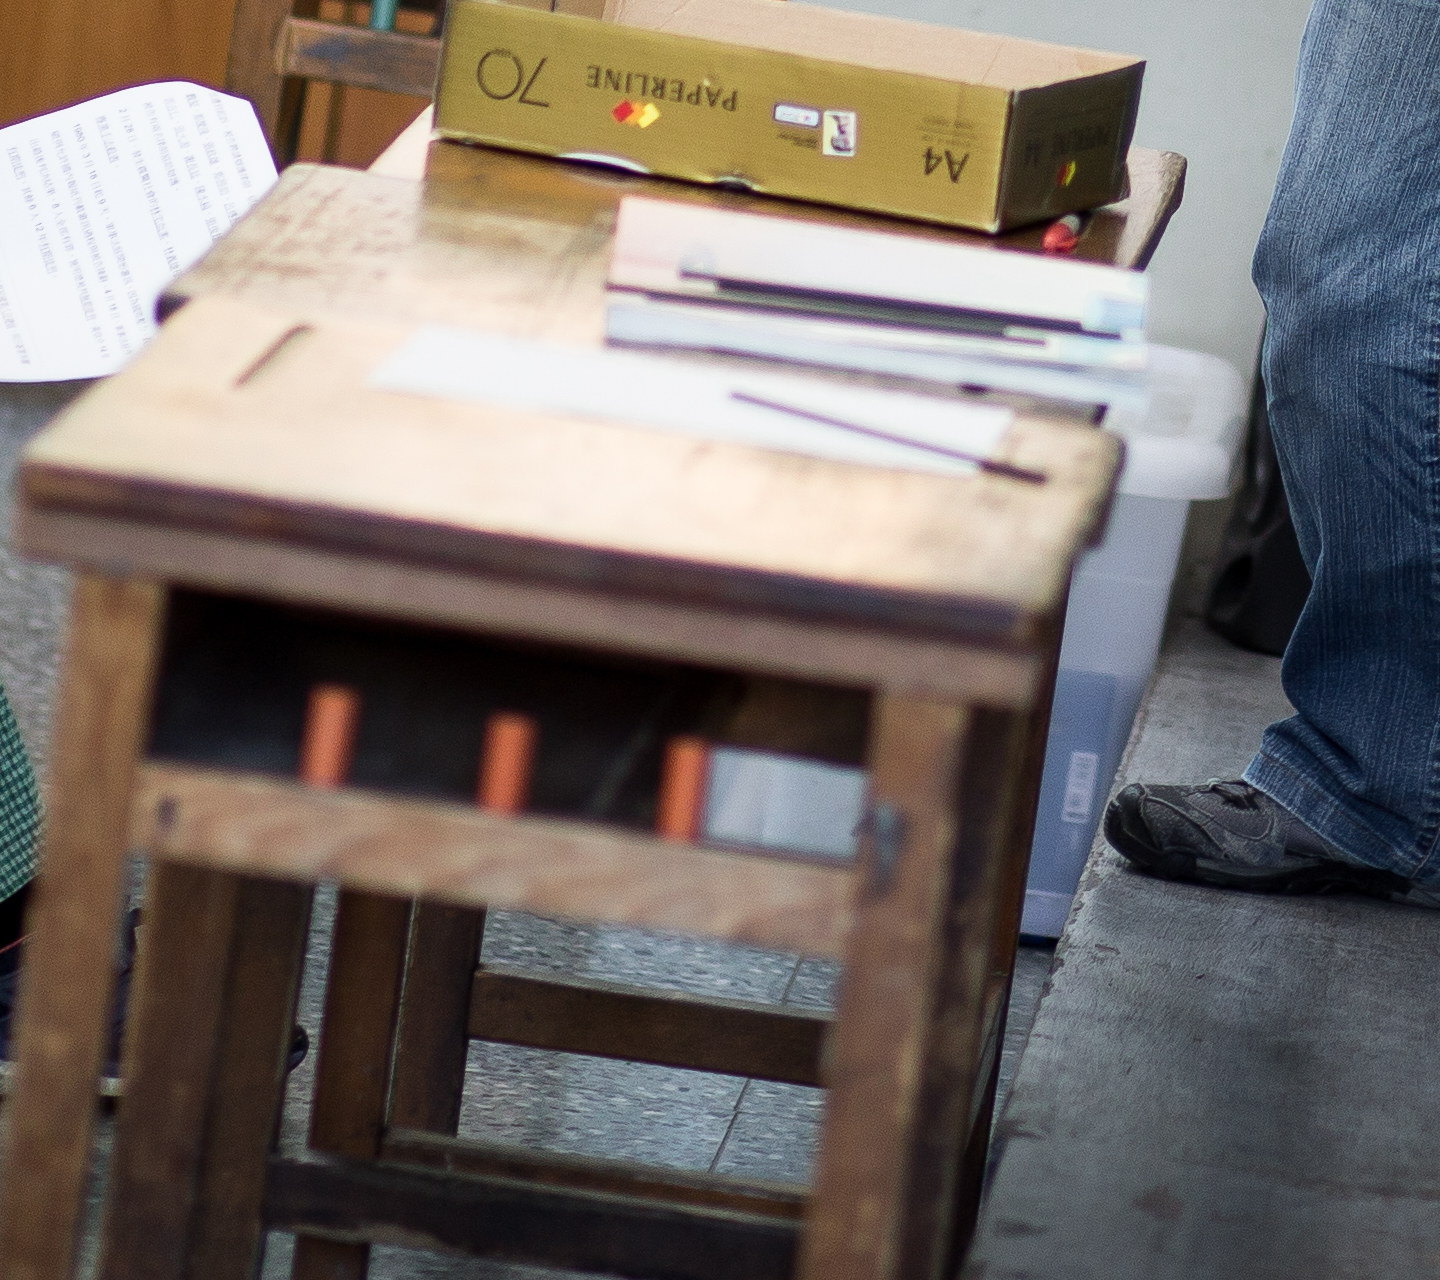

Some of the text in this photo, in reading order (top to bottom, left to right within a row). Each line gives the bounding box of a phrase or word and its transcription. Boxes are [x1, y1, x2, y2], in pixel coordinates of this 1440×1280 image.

[476, 48, 550, 109] 70
[586, 63, 739, 112] PAPERLINE
[922, 147, 970, 184] A4
